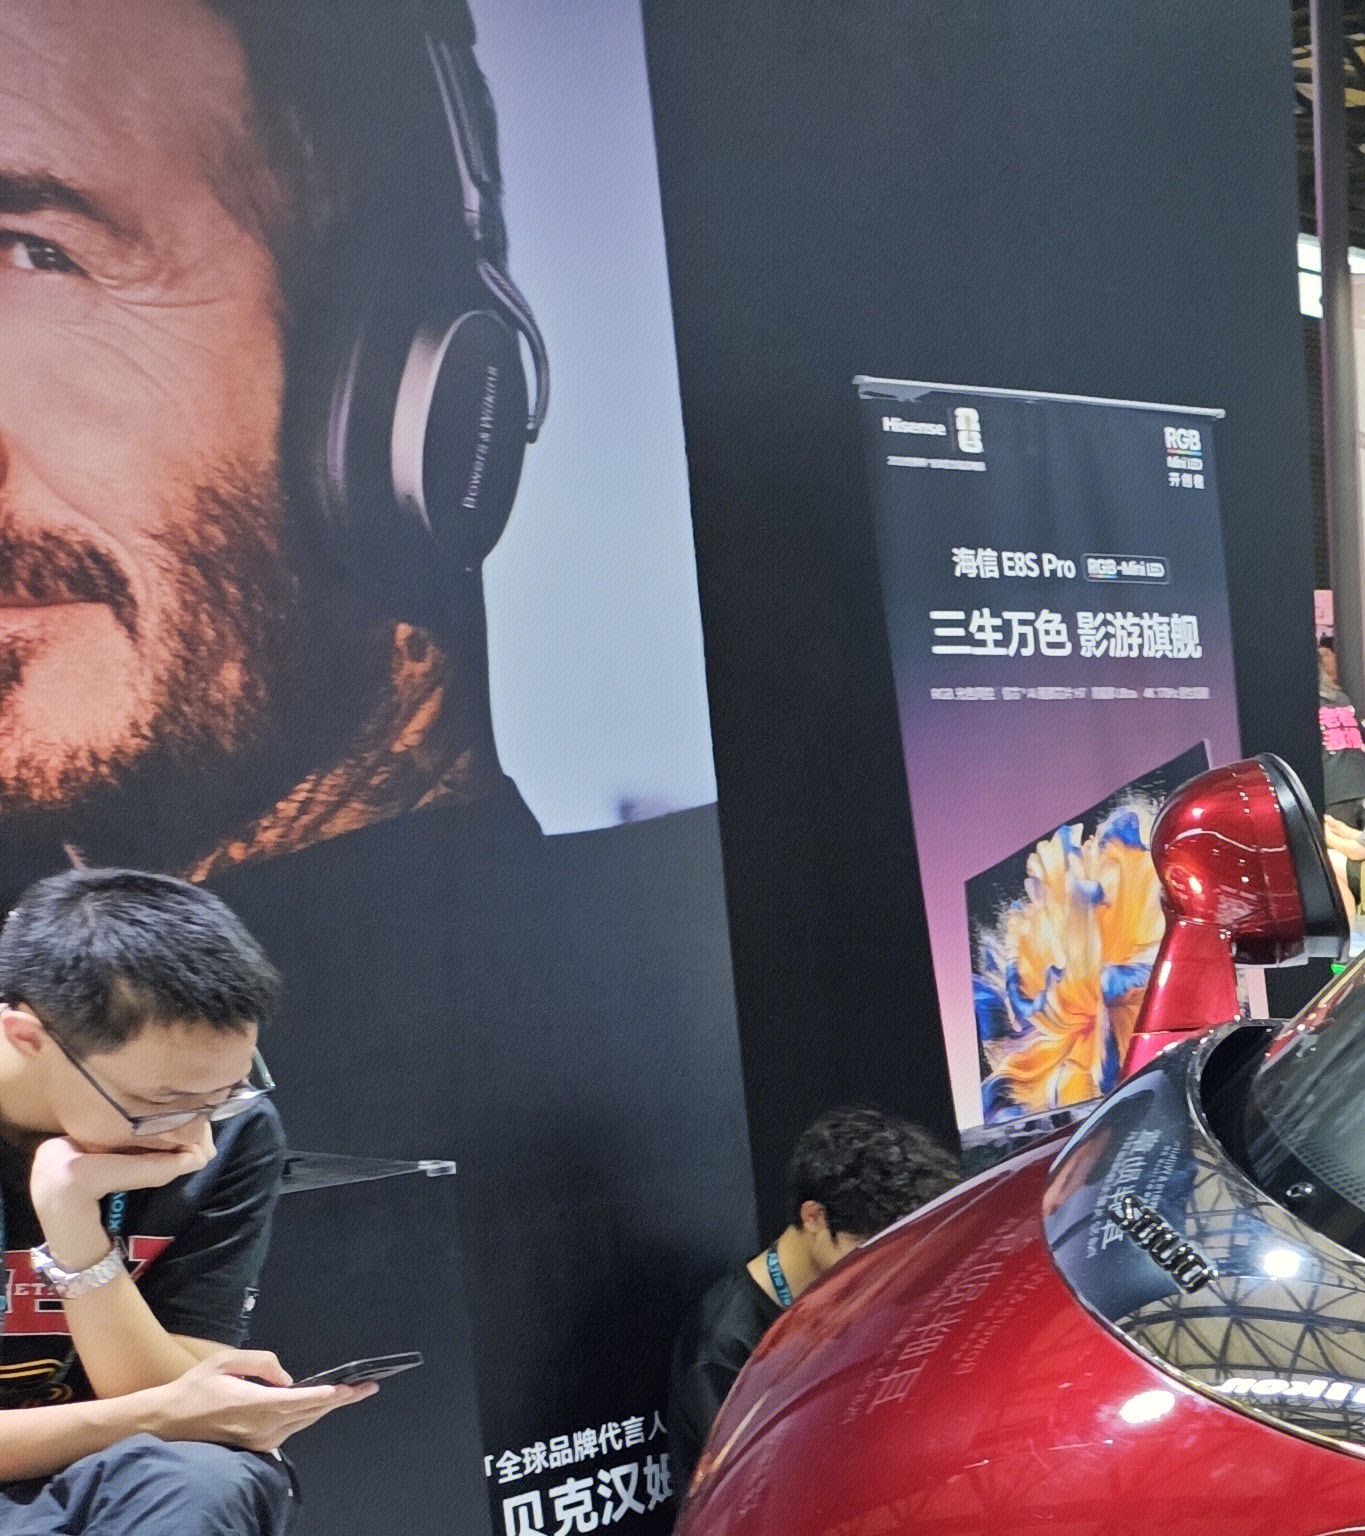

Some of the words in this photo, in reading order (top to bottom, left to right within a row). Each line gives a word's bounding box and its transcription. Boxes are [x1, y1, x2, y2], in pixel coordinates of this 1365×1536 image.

[1164, 427, 1202, 450] RGB
[952, 547, 1000, 579] 海信
[1002, 552, 1039, 577] E8S
[1042, 553, 1076, 579] Pro
[929, 608, 1073, 657] 三生万色
[1076, 611, 1203, 659] 影游旗舰
